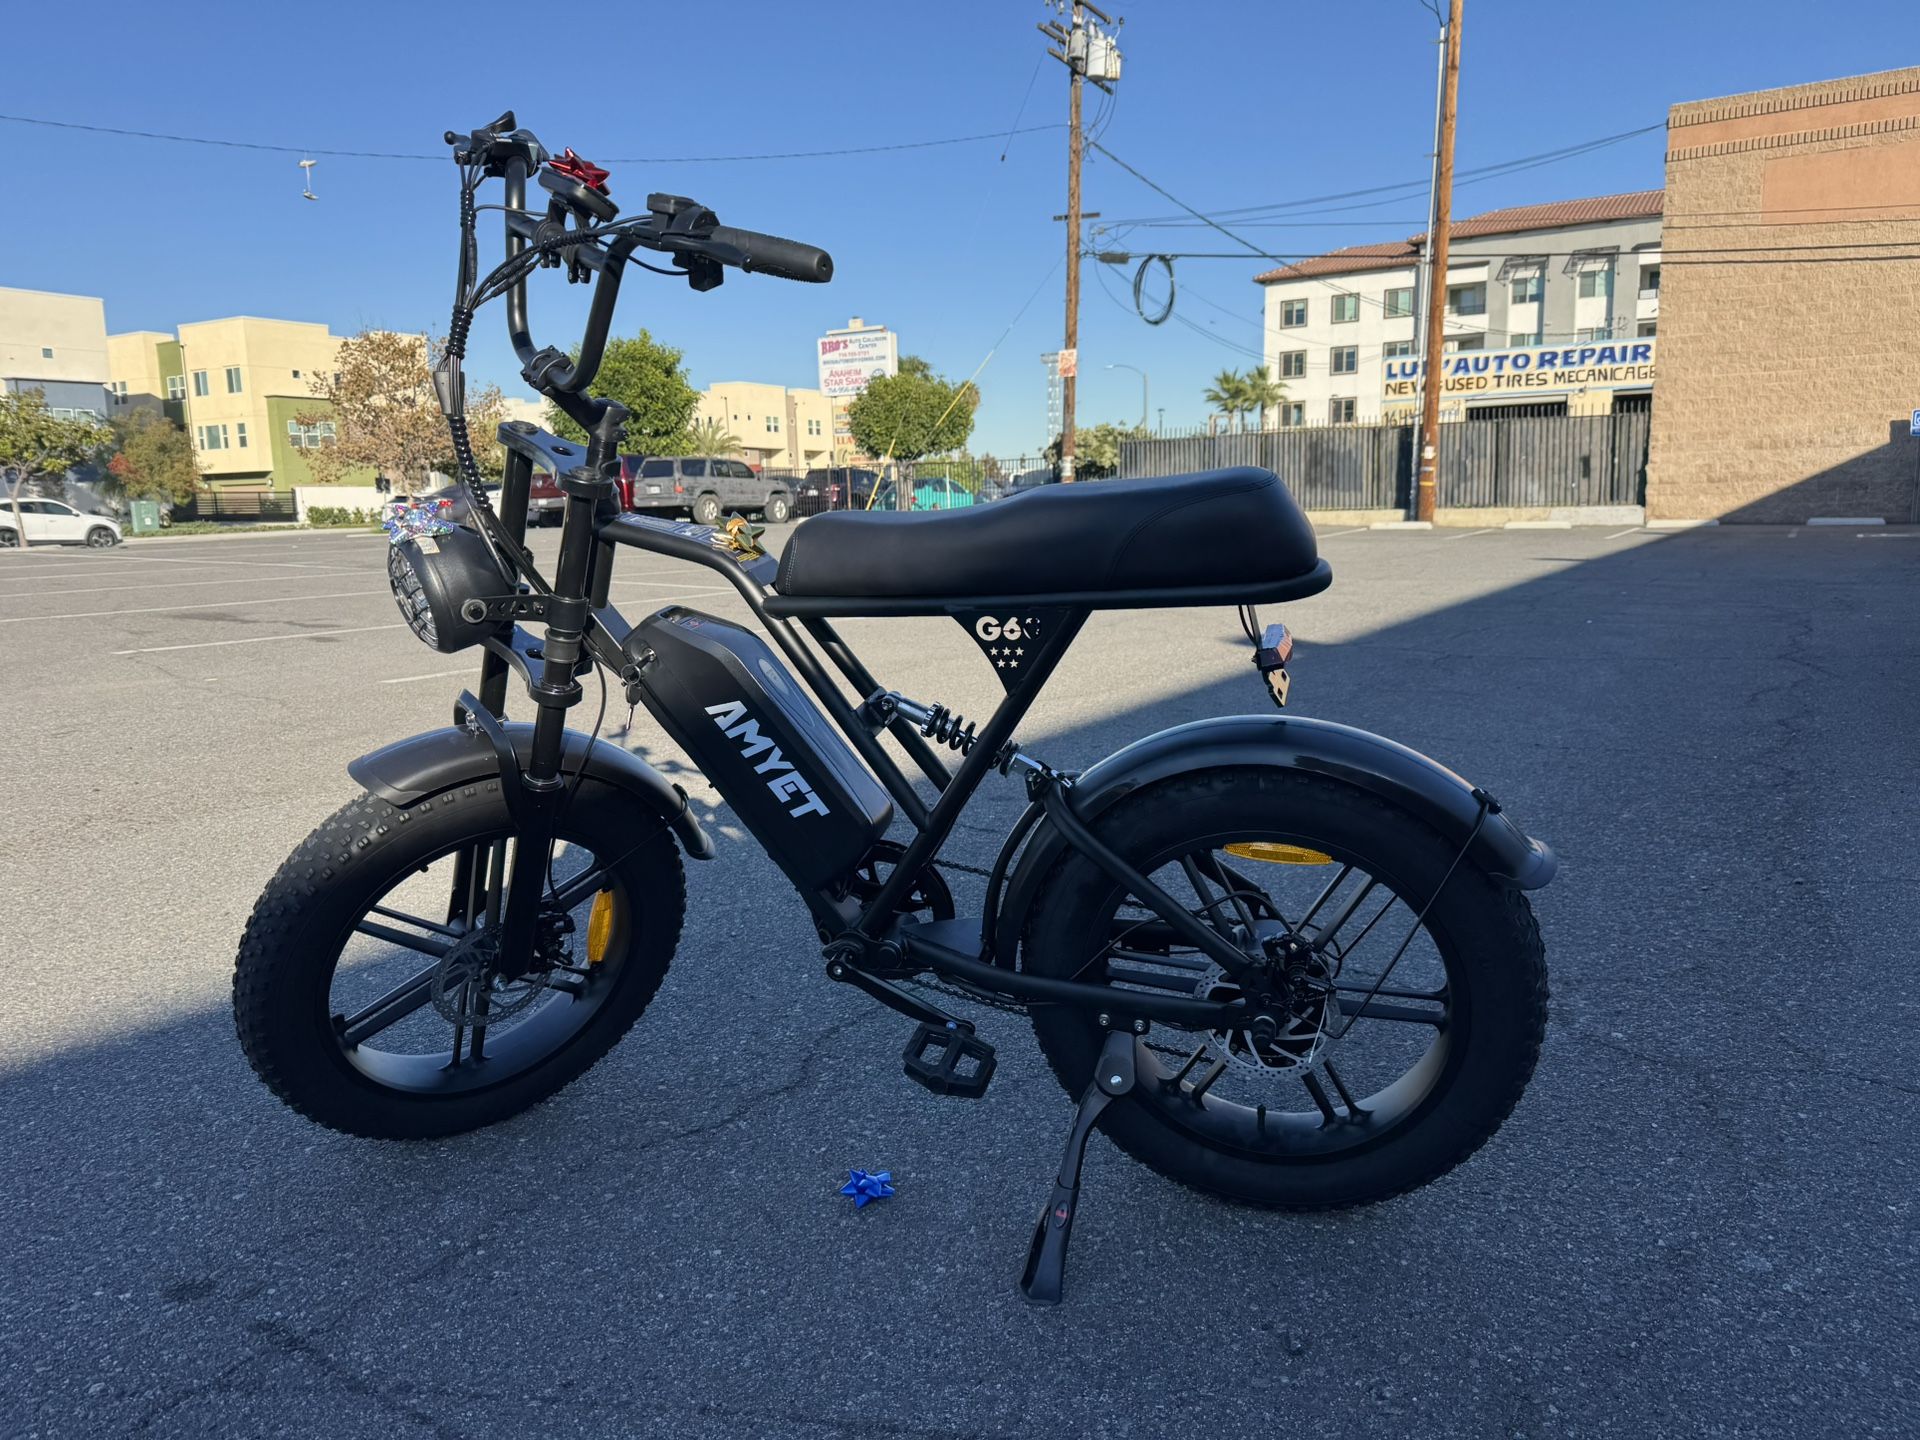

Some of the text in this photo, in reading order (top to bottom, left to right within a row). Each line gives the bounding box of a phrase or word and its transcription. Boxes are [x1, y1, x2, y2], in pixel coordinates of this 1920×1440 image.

[1453, 354, 1531, 375] AUTO
[1537, 344, 1652, 370] REPAIR
[828, 368, 862, 378] ANAHEIM
[1446, 377, 1487, 391] USED
[1493, 372, 1548, 388] TIRES
[824, 379, 844, 387] STAR
[704, 700, 831, 818] AMYET
